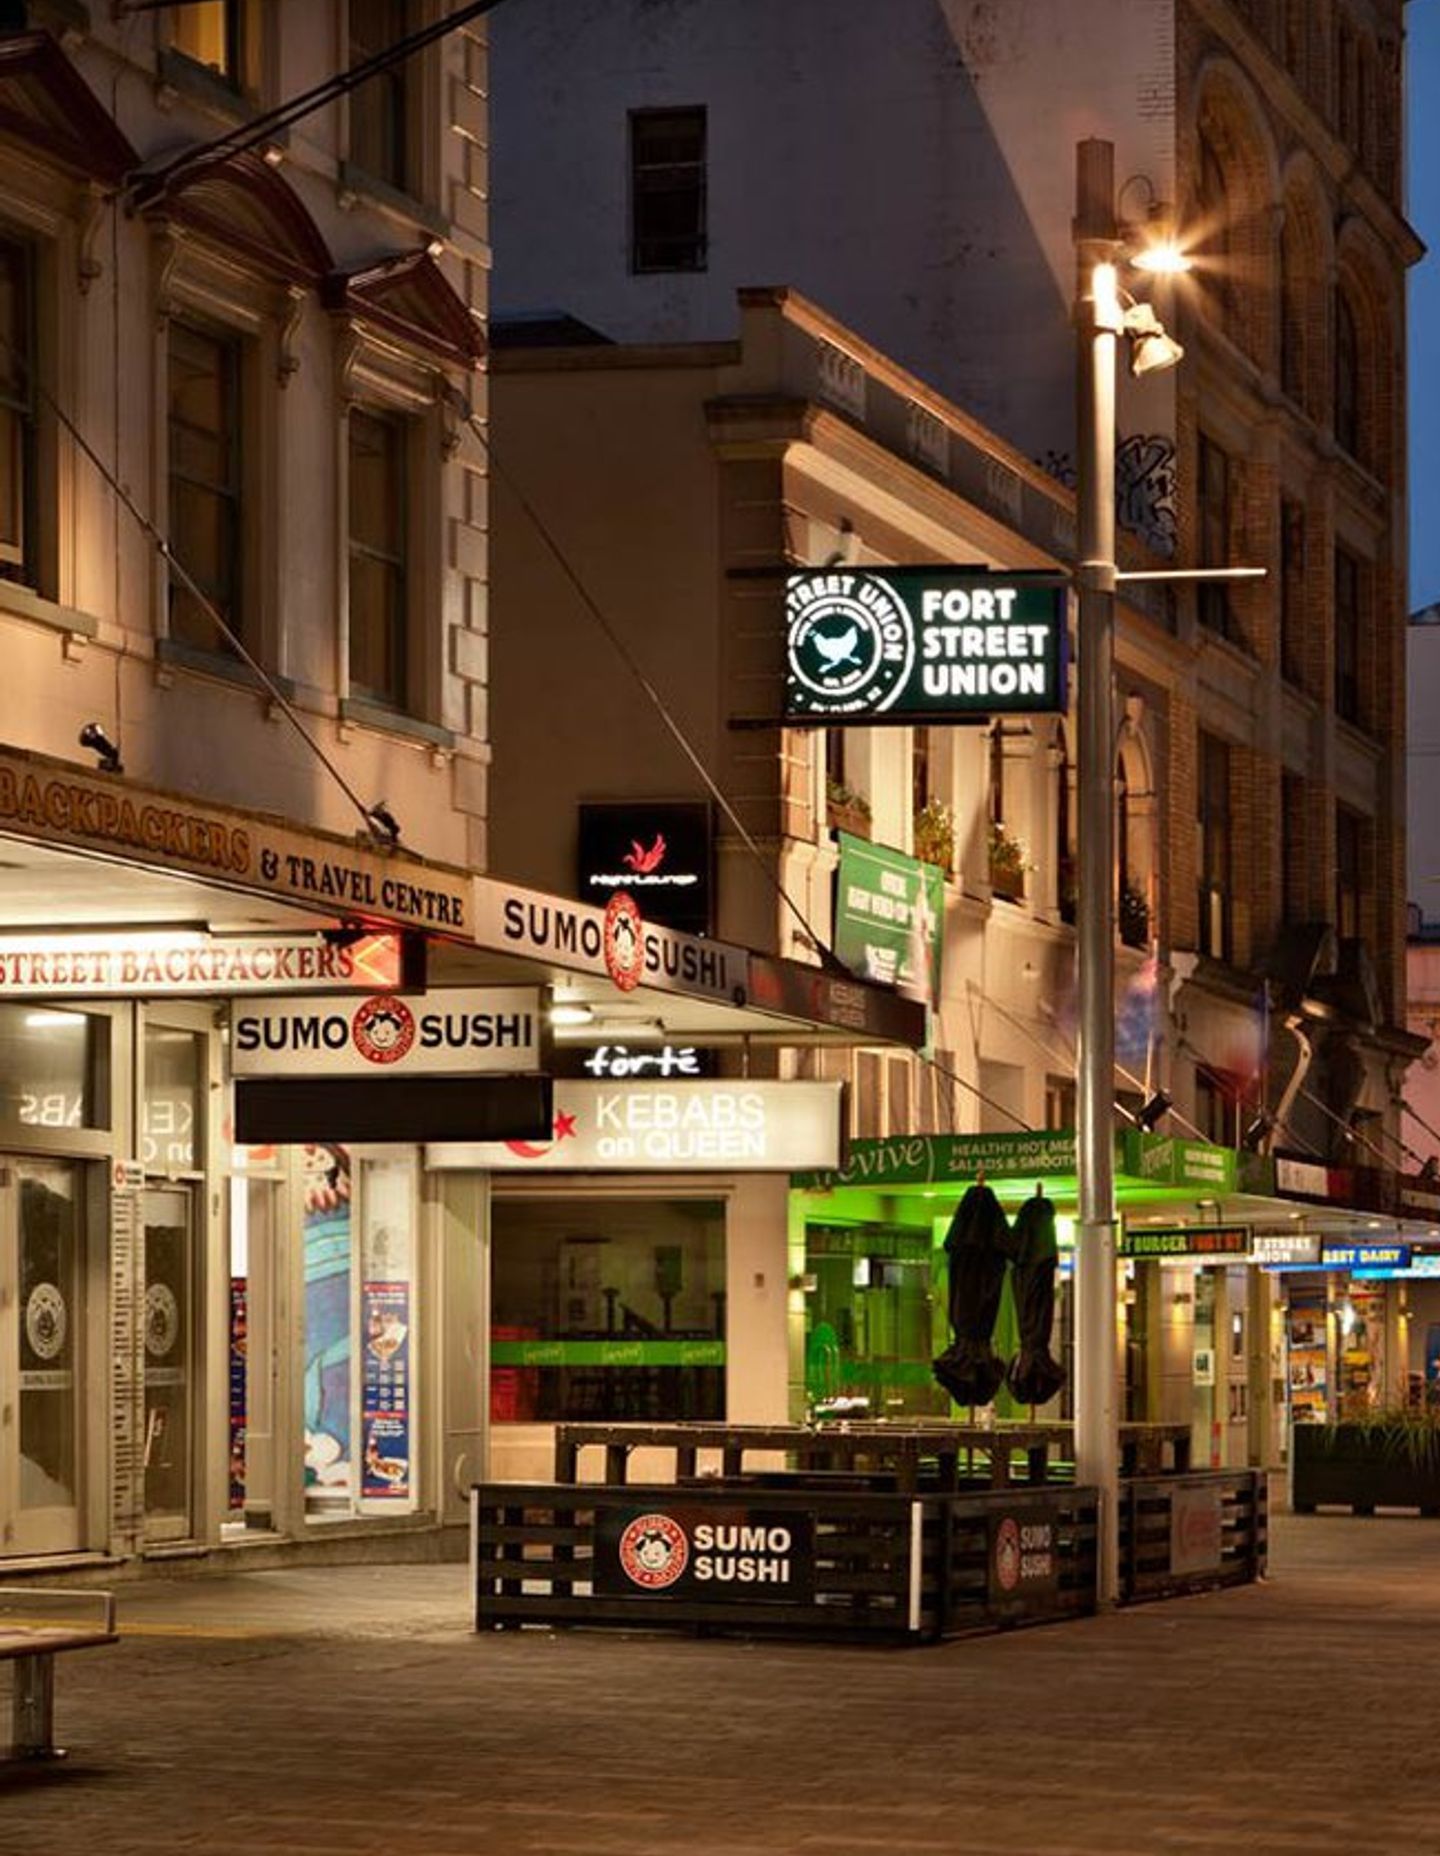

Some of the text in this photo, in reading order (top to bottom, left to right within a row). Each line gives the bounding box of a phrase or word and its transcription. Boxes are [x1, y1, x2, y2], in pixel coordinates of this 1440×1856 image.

[858, 583, 904, 661] UNION
[922, 589, 1016, 621] FORT
[922, 626, 1049, 659] STREET
[922, 664, 1046, 695] UNION
[0, 766, 464, 927] BACKPACKERS & TRAVEL CENTRE
[504, 898, 601, 958] SUMO
[645, 935, 726, 990] SUSHI
[120, 946, 354, 983] BACKPACKERS
[237, 1015, 349, 1051] SUMO
[419, 1014, 532, 1048] SUSHI
[596, 1093, 766, 1130] KEBABS
[597, 1131, 767, 1159] on QUEEN
[693, 1525, 792, 1553] SUMO
[693, 1556, 790, 1583] SUSHI
